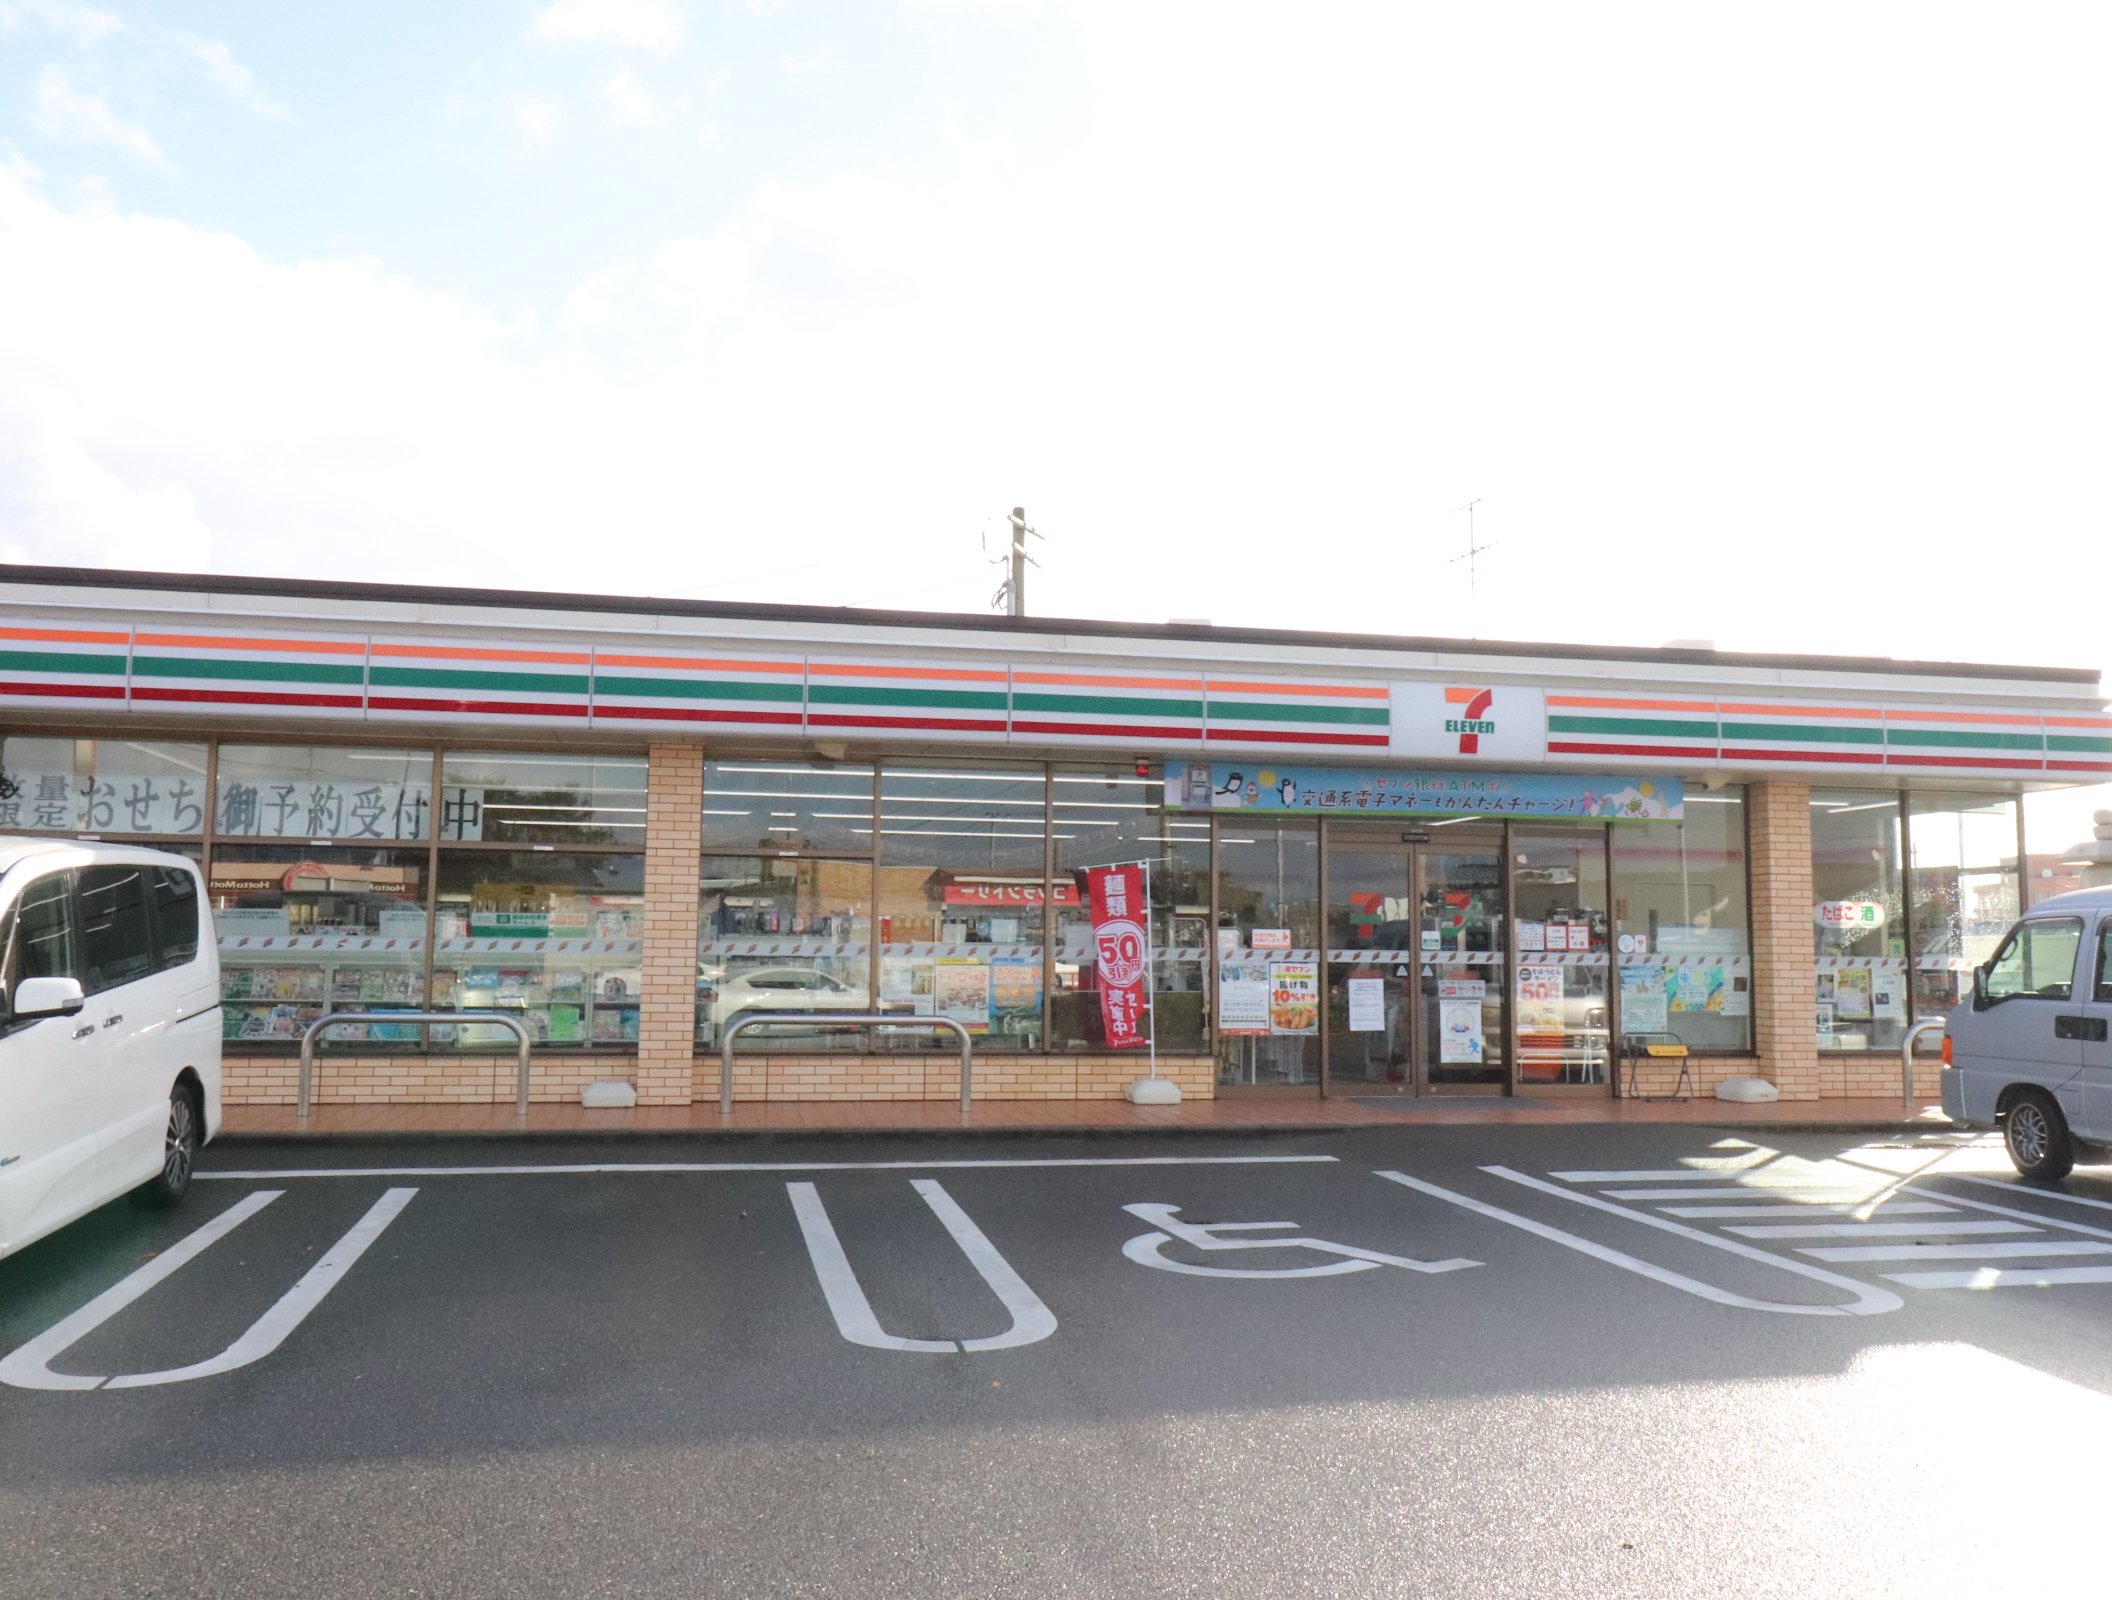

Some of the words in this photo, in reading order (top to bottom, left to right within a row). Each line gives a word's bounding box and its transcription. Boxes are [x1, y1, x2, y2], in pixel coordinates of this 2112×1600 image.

[1445, 688, 1492, 753] 7
[1822, 905, 1854, 921] たばこ
[1861, 906, 1874, 921] 酒
